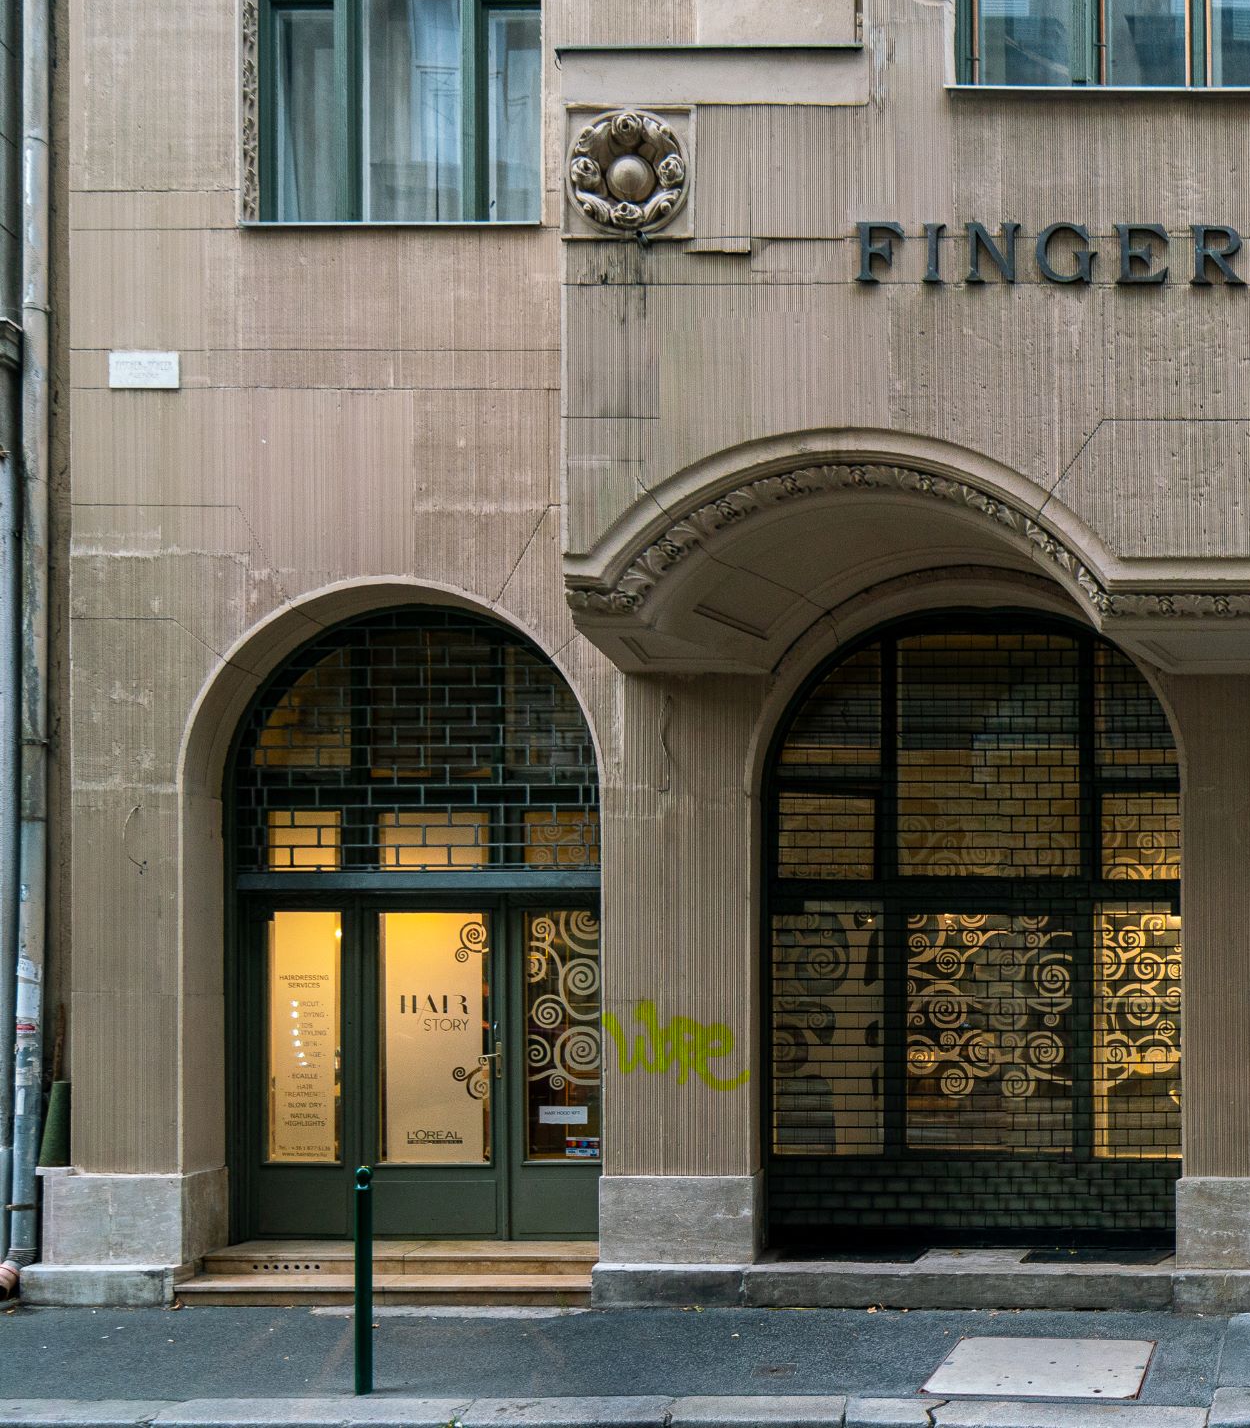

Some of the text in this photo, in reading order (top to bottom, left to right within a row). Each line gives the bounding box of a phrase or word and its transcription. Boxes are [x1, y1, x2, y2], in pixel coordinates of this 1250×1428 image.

[855, 221, 1248, 288] FINGER
[399, 994, 470, 1015] HAIR
[423, 1018, 470, 1032] STORY
